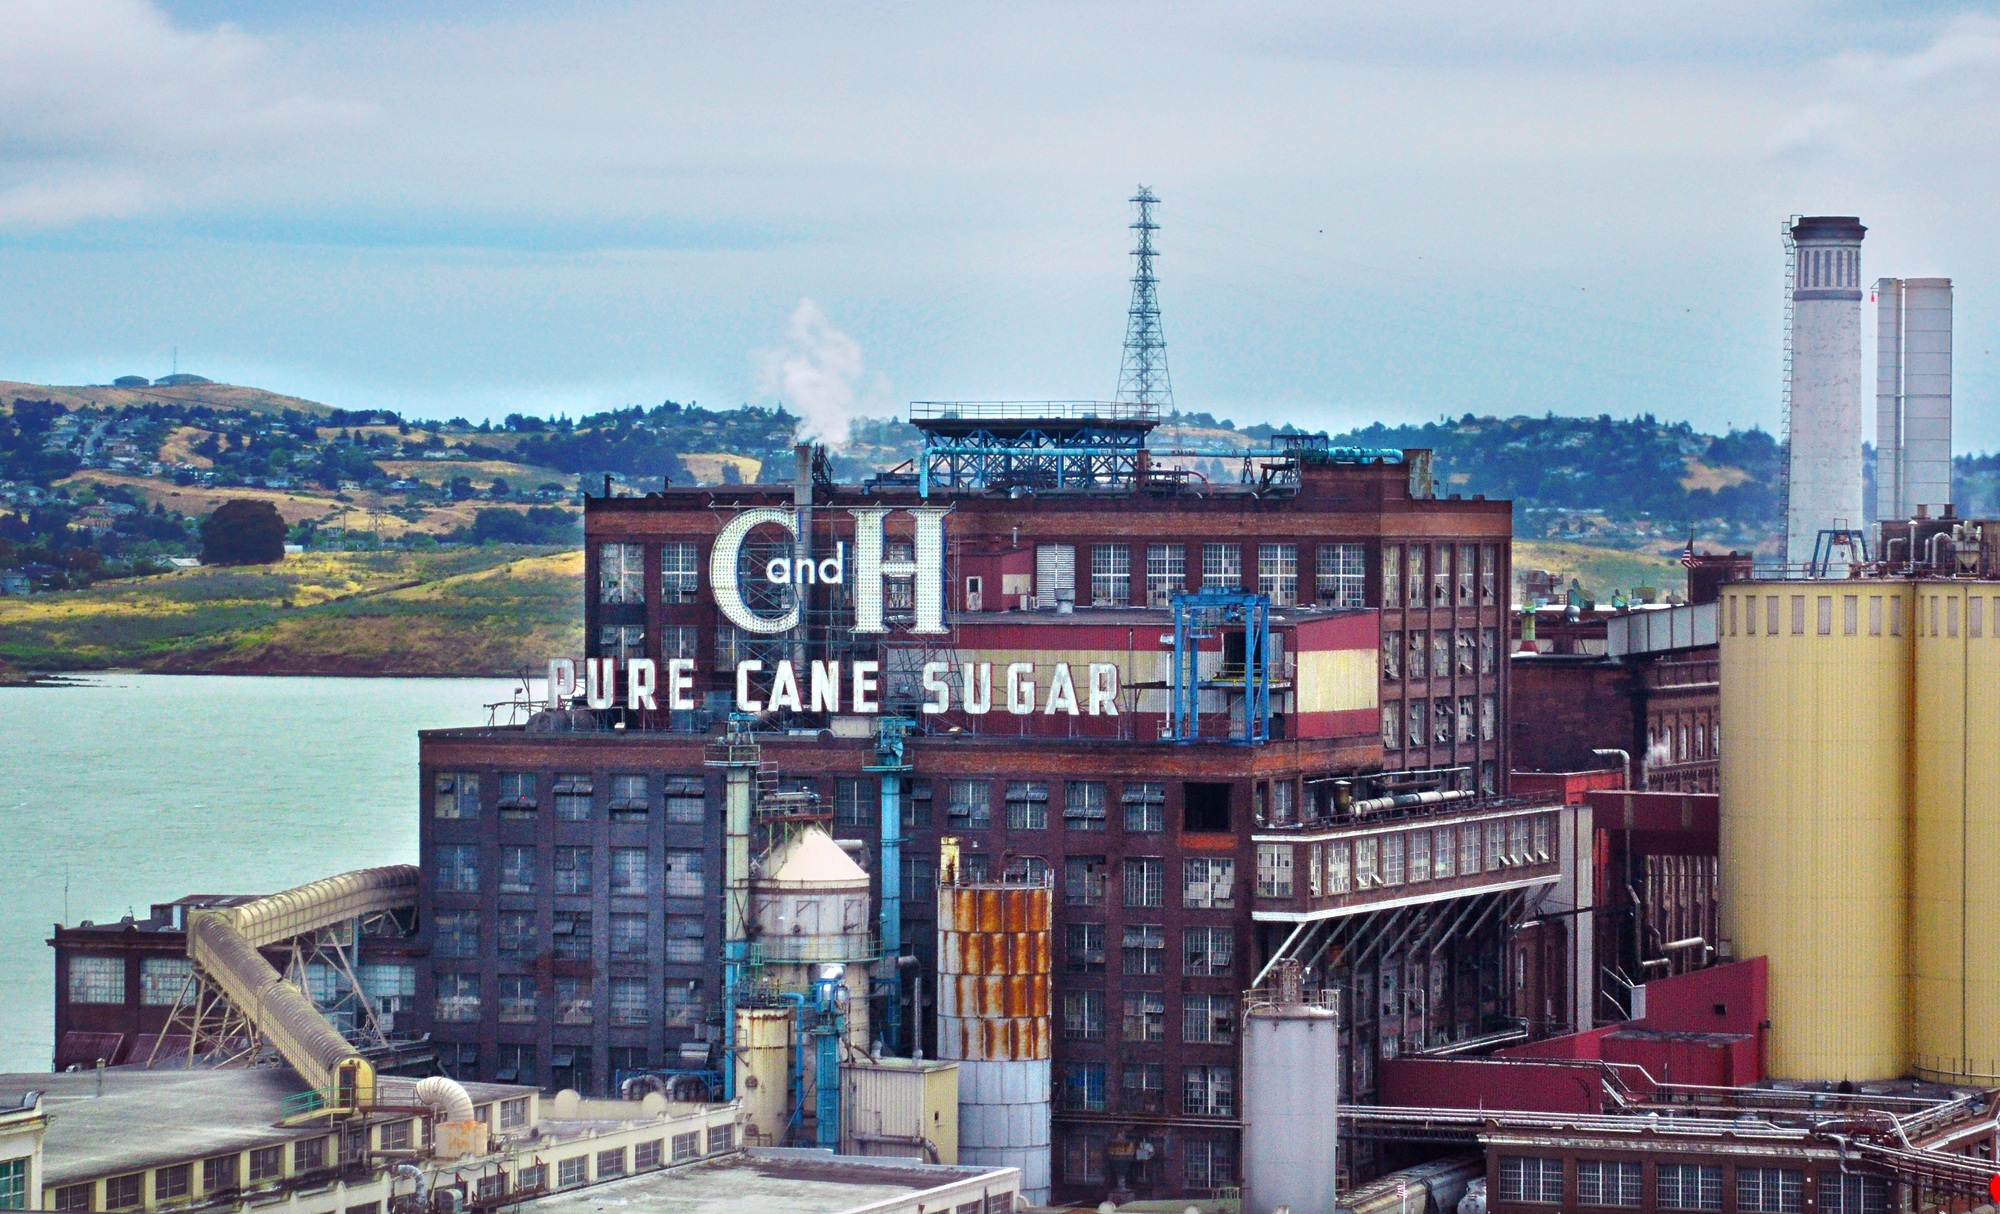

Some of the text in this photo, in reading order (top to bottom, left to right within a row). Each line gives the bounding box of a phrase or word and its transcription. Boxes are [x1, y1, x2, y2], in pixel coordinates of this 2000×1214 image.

[709, 508, 951, 634] C and H
[548, 658, 1119, 716] PURE CANE SUGAR
